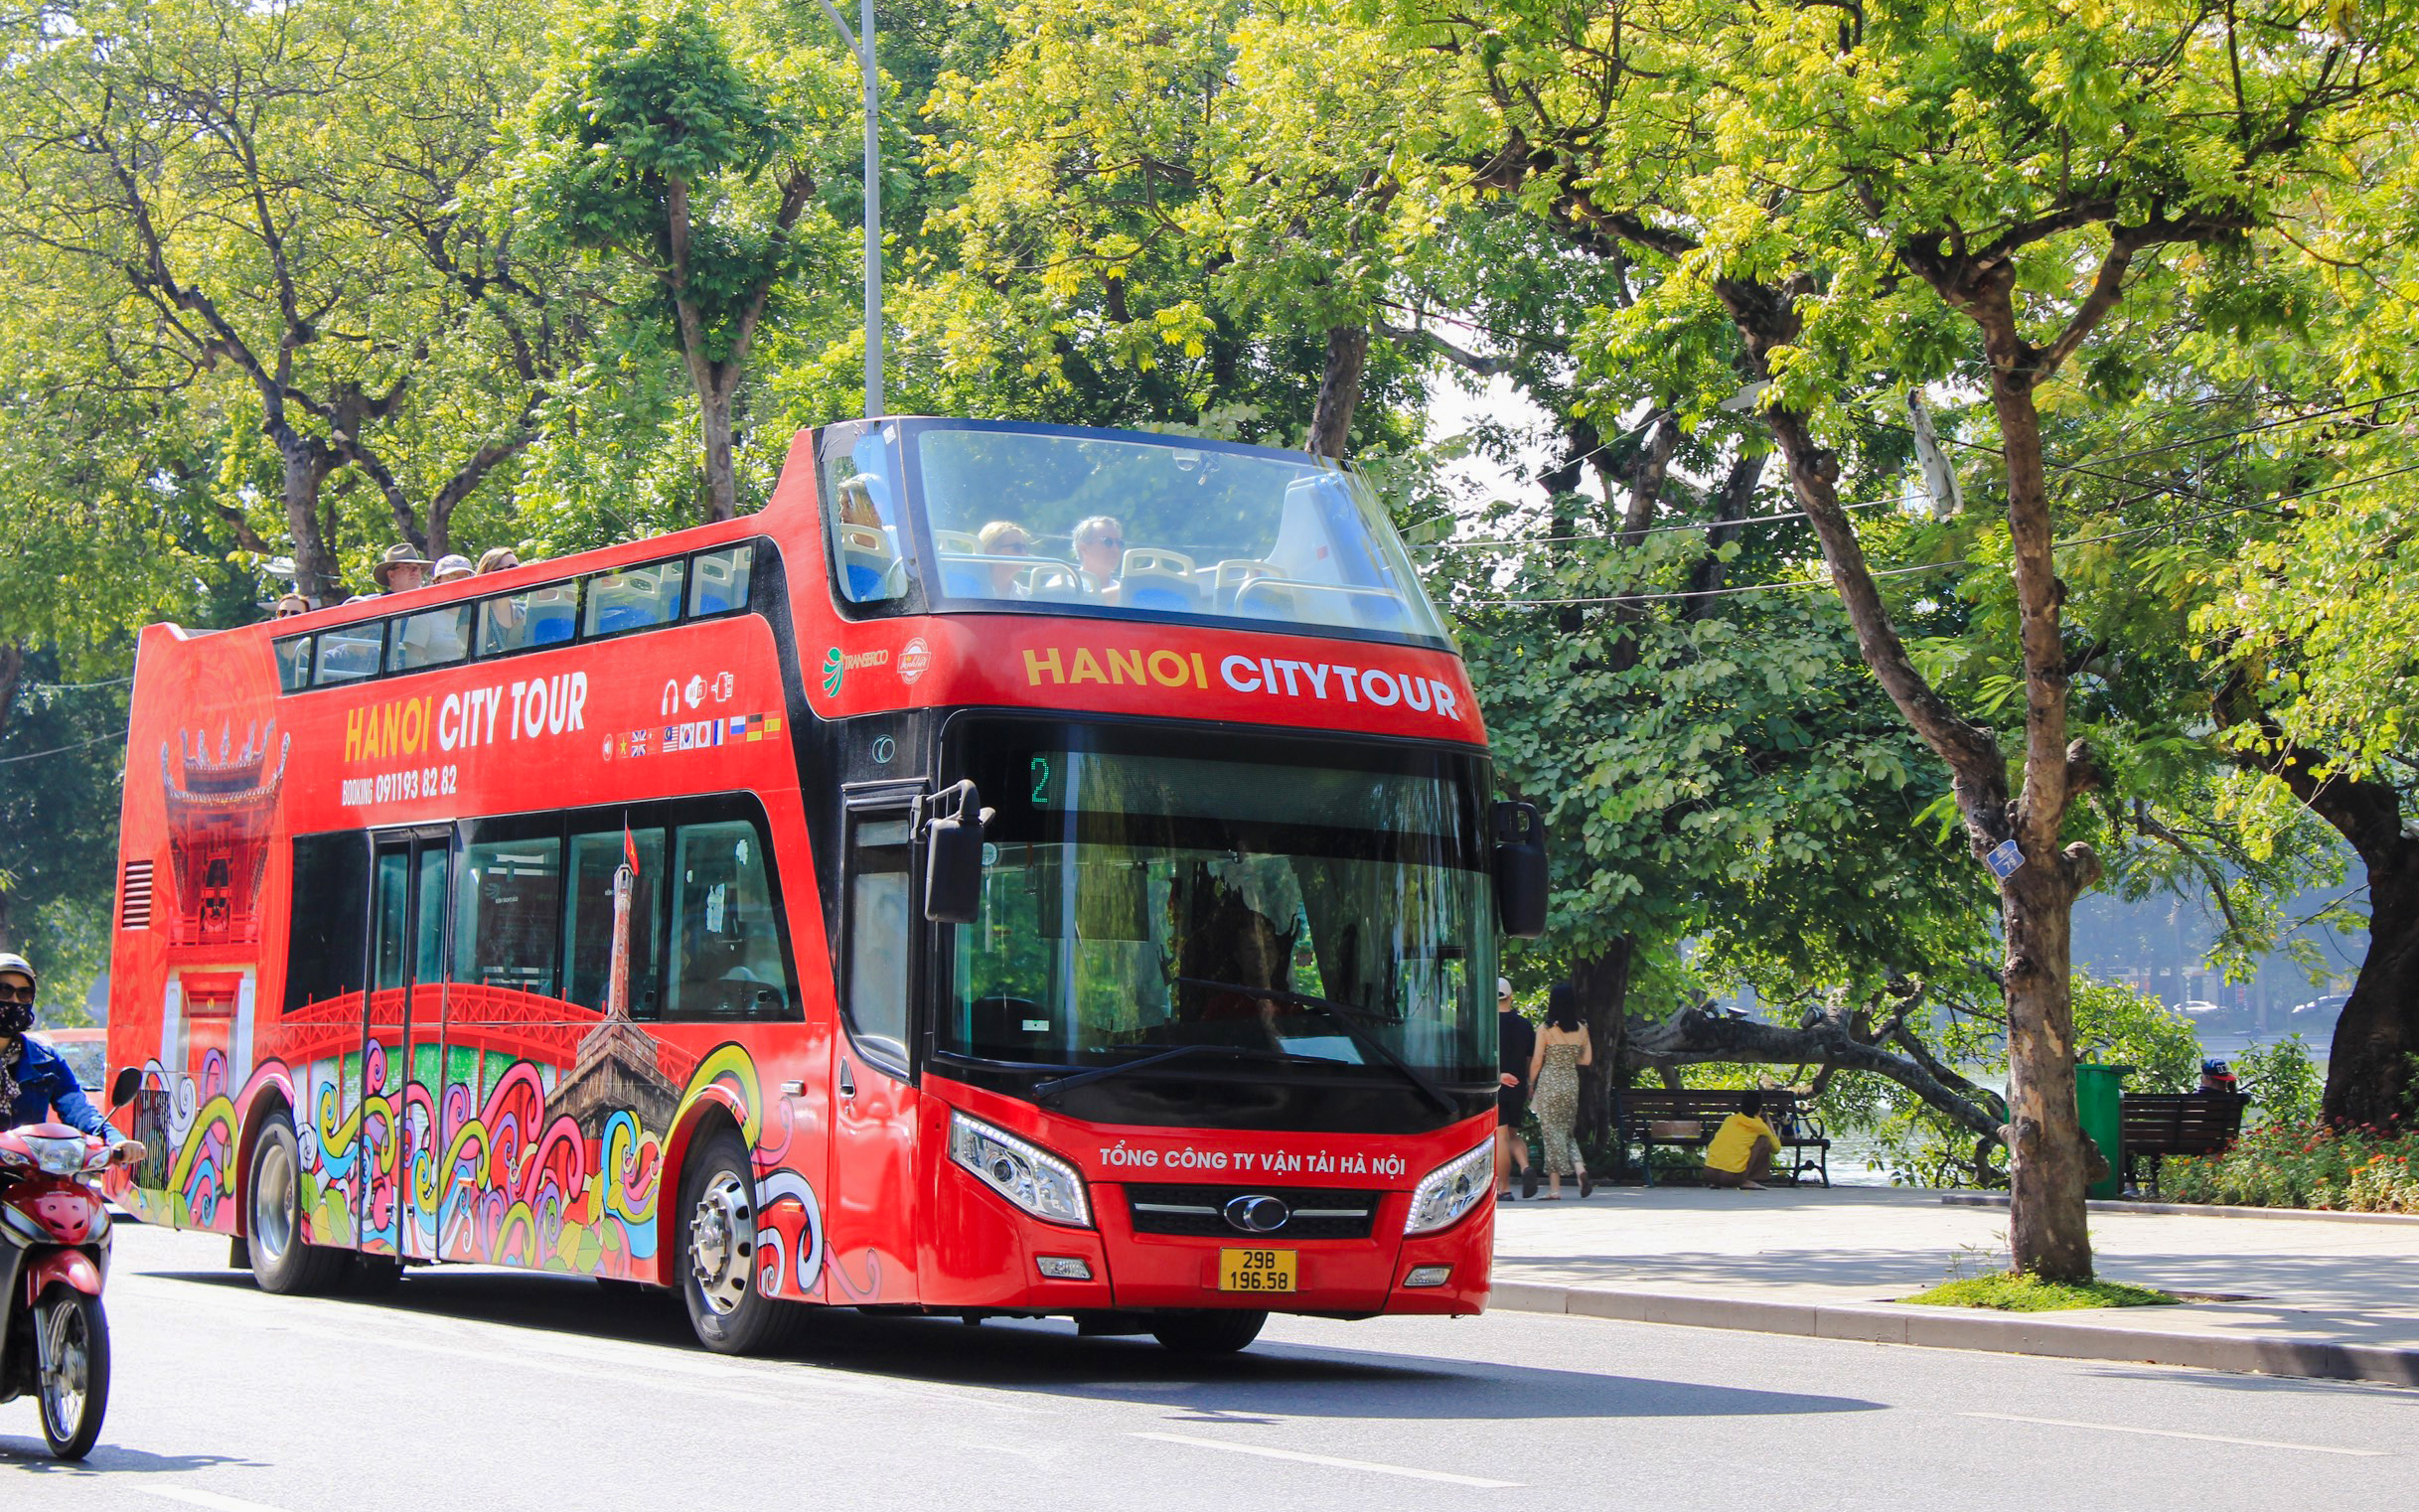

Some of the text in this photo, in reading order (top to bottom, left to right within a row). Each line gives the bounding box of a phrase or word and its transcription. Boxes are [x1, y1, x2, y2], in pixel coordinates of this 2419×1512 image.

[1022, 648, 1208, 689] HANOI
[345, 672, 588, 762] HANOI CITY TOUR
[342, 764, 457, 806] BOOKING 091193 82 82
[1031, 758, 1049, 803] 2
[2003, 857, 2017, 869] 79
[1100, 1139, 1406, 1180] TỔNG CÔNG TY VẬN TẢI HÀ NỘI
[1231, 1271, 1287, 1289] 196.58
[1243, 1251, 1275, 1269] 29B
